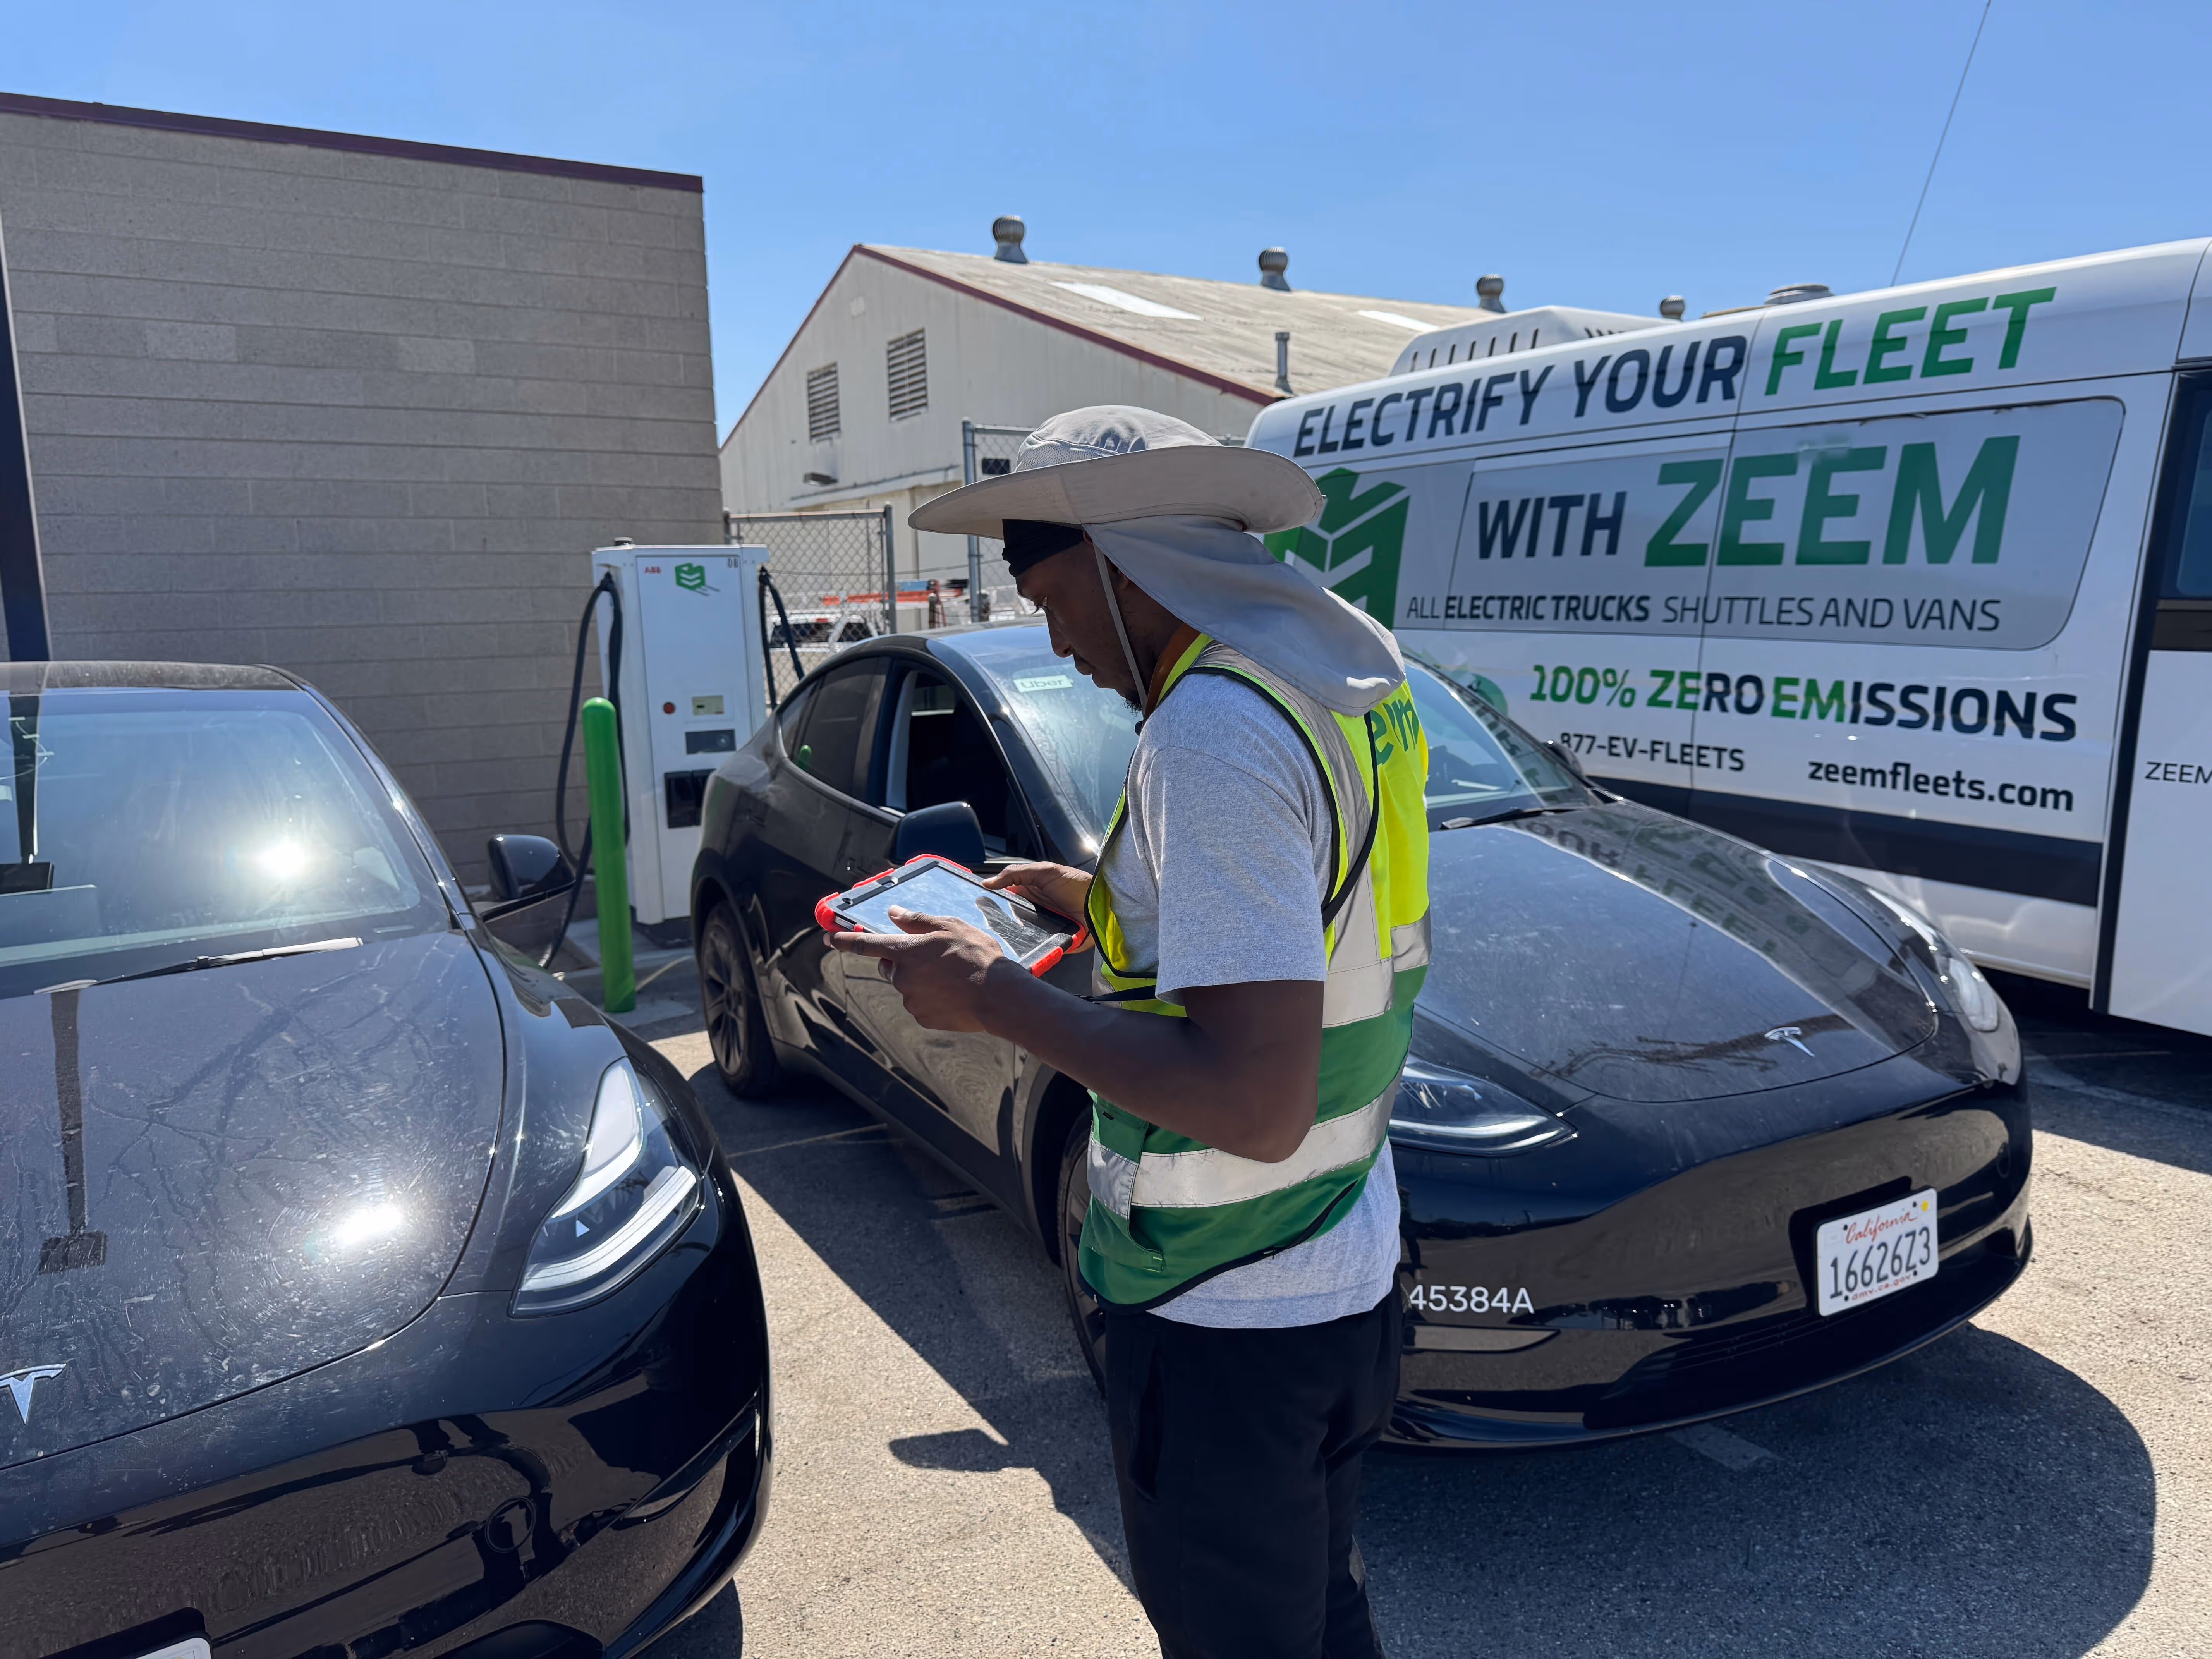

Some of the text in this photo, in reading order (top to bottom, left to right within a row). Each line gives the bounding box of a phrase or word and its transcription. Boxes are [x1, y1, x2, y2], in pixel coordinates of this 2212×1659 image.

[1293, 286, 2057, 457] ELECTRIFY YOUR FLEET
[1478, 434, 2020, 567] WITH ZEEM
[1407, 595, 2001, 631] ALL ELECTRIC TRUCKS SHUTTLES AND VANS
[1530, 665, 2078, 741] 100% ZERO EMISSIONS
[1560, 732, 1745, 771] 877-EV-FLEETS
[1808, 761, 2074, 811] zeemfleets.com
[1846, 1211, 1917, 1244] California
[1829, 1226, 1930, 1299] 16626Z3
[1410, 1285, 1535, 1314] 45384A
[1852, 1274, 1911, 1300] dmv.ca.gov
